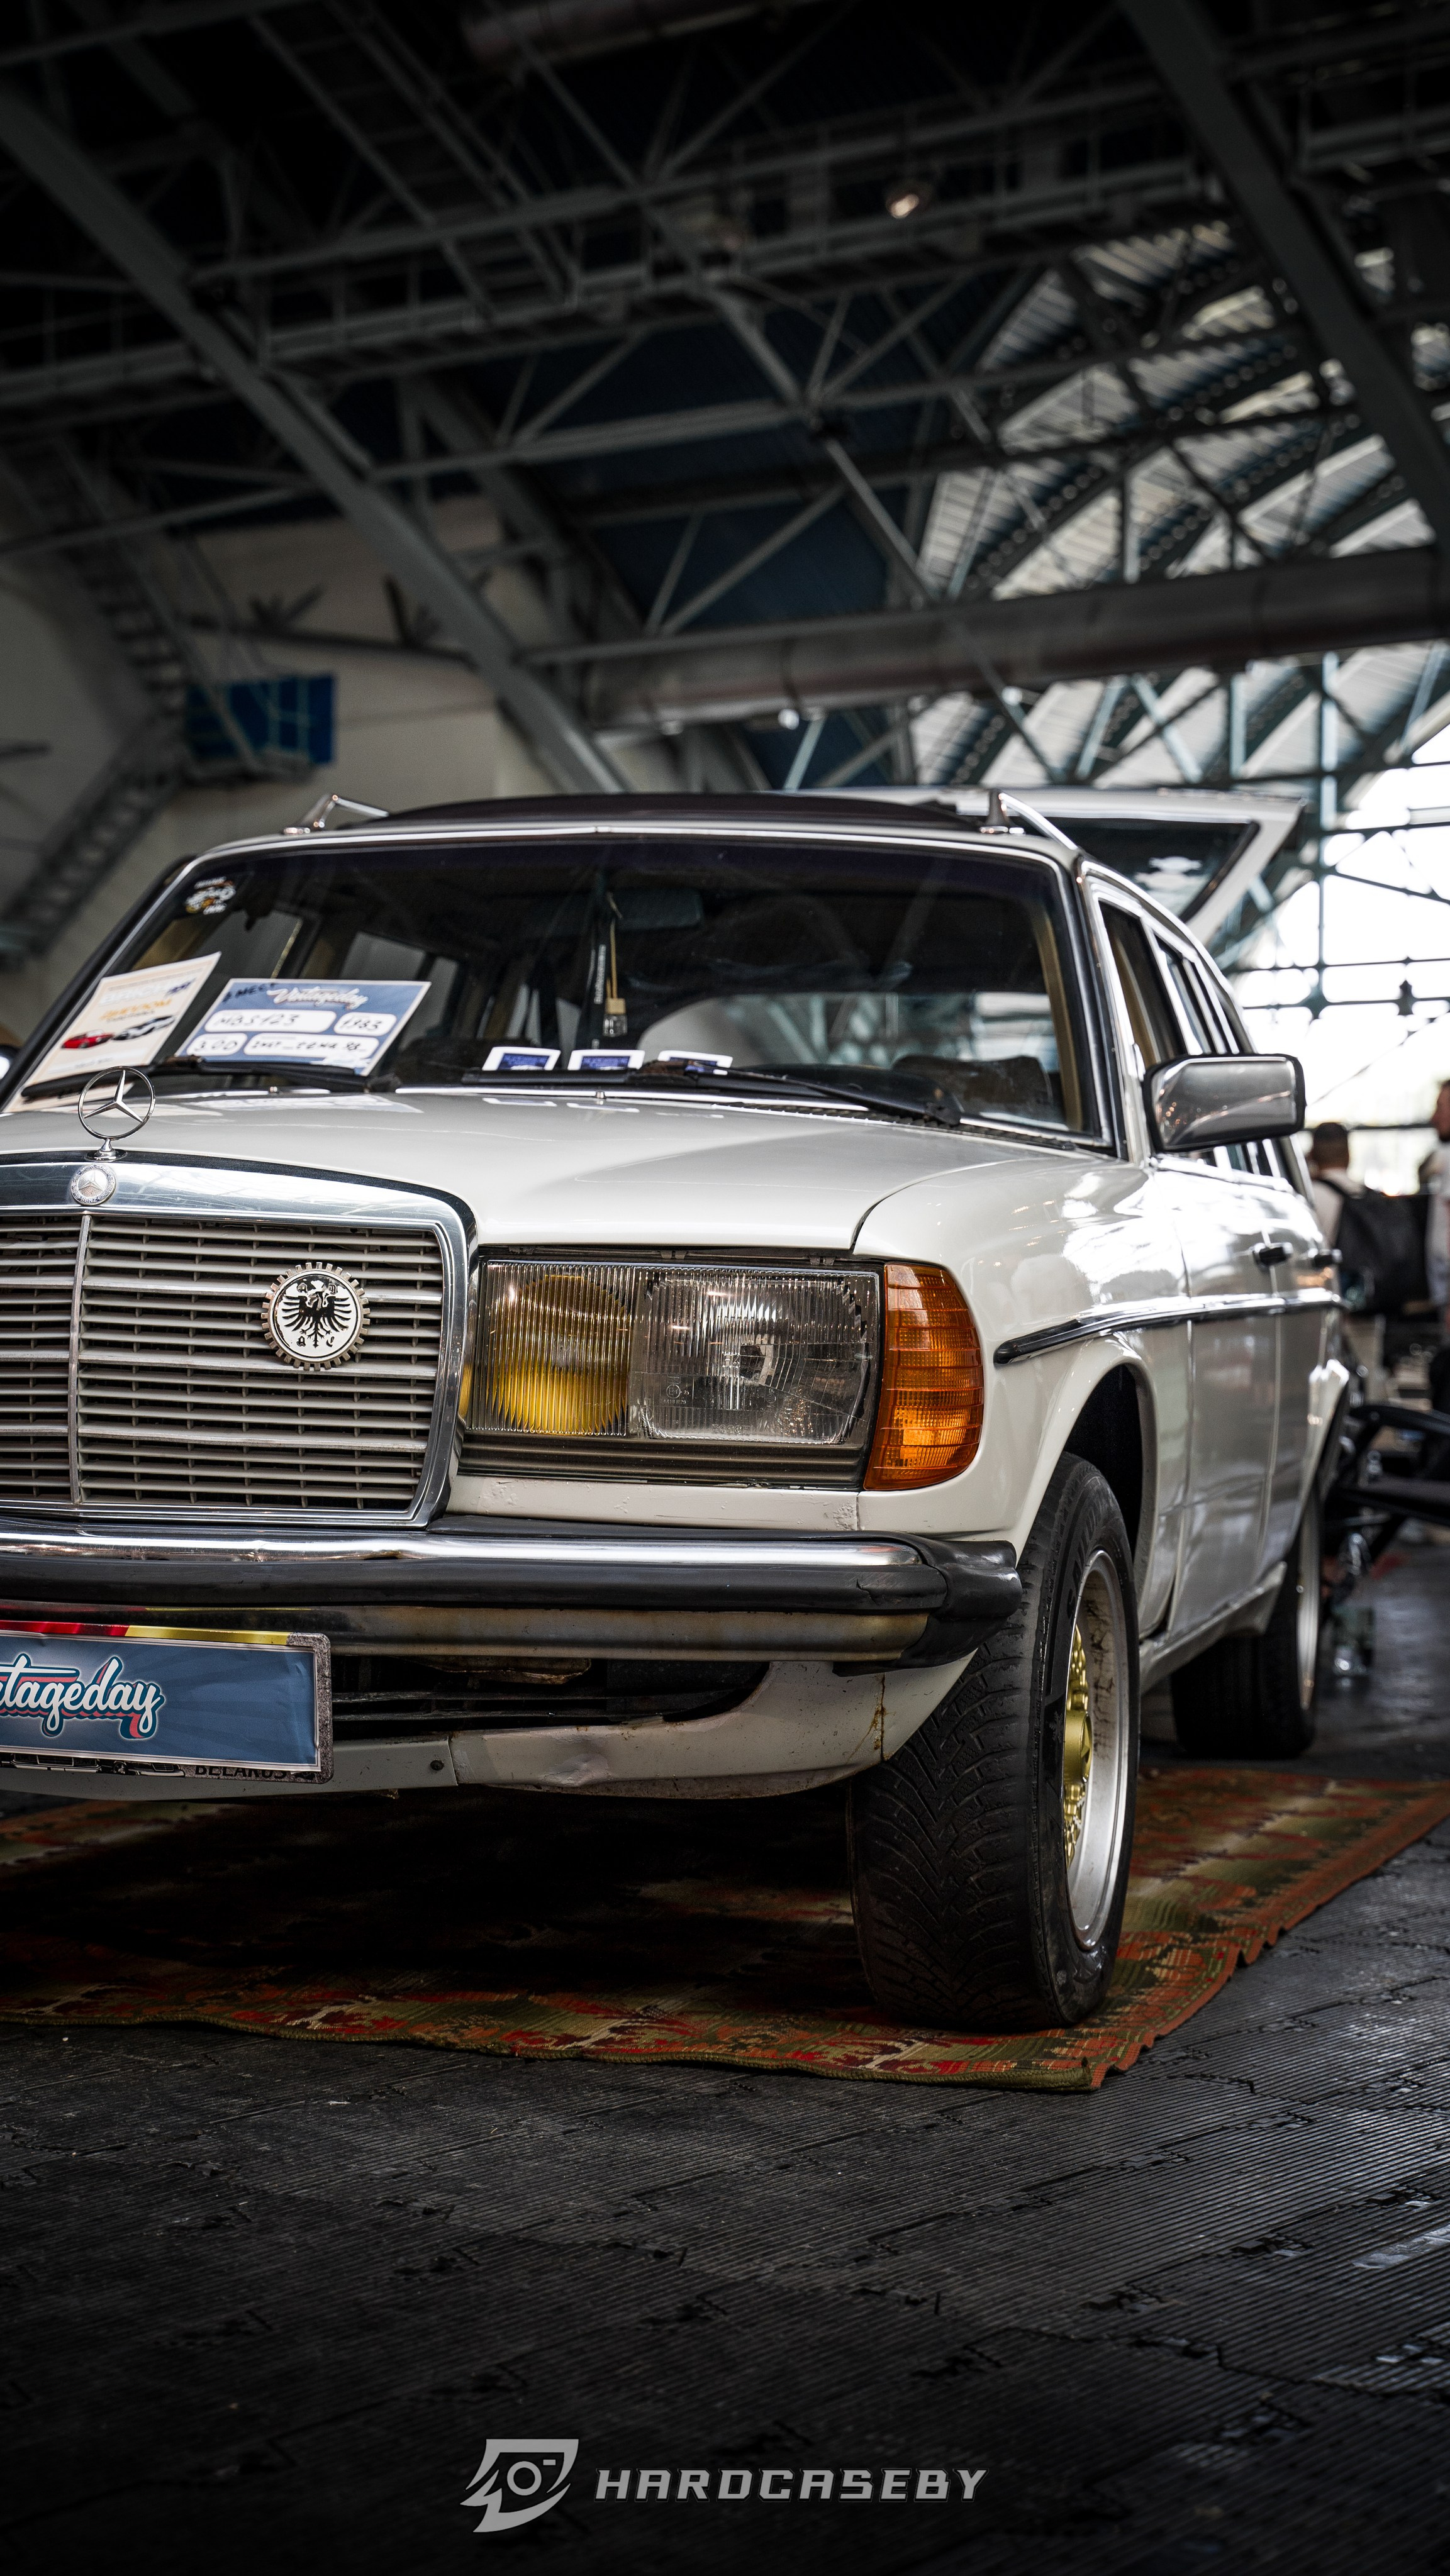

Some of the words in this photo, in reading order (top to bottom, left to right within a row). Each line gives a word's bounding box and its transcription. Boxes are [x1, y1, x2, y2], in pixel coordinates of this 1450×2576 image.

[266, 986, 369, 1010] Vintageday
[711, 1424, 751, 1435] BOSCH
[0, 1653, 165, 1739] tageday
